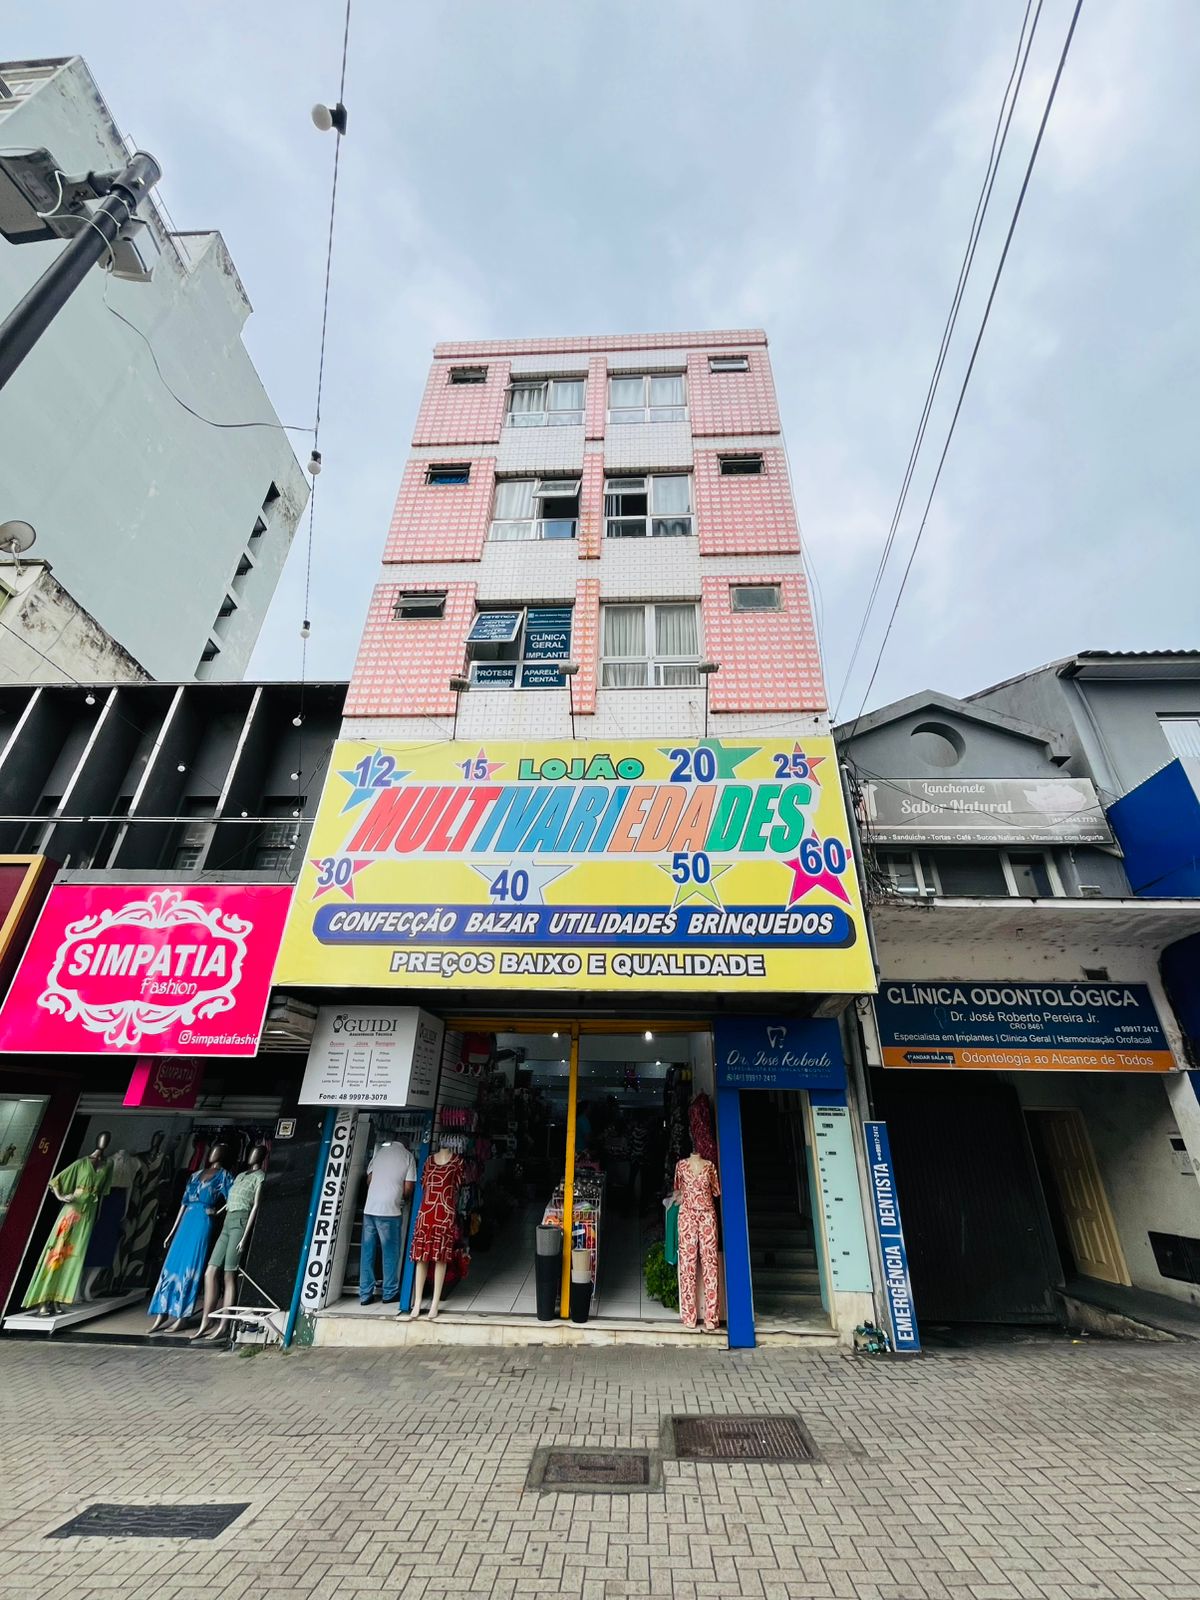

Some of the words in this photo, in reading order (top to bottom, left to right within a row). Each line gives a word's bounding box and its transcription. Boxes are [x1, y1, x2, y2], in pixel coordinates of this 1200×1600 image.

[530, 633, 566, 641] CLÍNICA
[532, 641, 564, 649] GERAL
[525, 651, 569, 659] IMPLANTE
[474, 669, 514, 677] PRÓTESE
[523, 668, 559, 676] APARELH
[355, 755, 396, 788] 12
[461, 758, 488, 780] 15
[517, 754, 645, 781] LOJÃO
[670, 749, 717, 783] 20
[772, 753, 809, 779] 25
[921, 783, 985, 796] Lanchonete
[900, 799, 945, 814] Sabor
[949, 799, 1014, 814] Natural
[345, 783, 813, 854] MULTIVARIEDADES
[799, 837, 847, 875] 60
[317, 857, 353, 886] 30
[672, 852, 711, 884] 50
[489, 869, 530, 901] 40
[327, 907, 459, 938] CONFECÇÃO
[463, 911, 541, 934] BAZAR
[547, 911, 678, 935] UTILIDADES
[686, 911, 835, 936] BRINQUEDOS
[67, 943, 227, 977] SIMPATIA
[389, 951, 495, 978] PREÇOS
[498, 952, 583, 975] BAIXO
[587, 953, 607, 975] E
[611, 953, 767, 977] QUALIDADE
[139, 977, 198, 996] Fashion
[886, 984, 968, 1005] CLÍNICA
[970, 985, 1140, 1007] ODONTOLÓGICA
[343, 1019, 399, 1032] GUIDI
[950, 1011, 967, 1022] Dr.
[969, 1011, 995, 1022] José
[997, 1011, 1041, 1023] Roberto
[1043, 1012, 1084, 1023] Pereira
[1086, 1012, 1100, 1024] Jr.
[893, 1032, 941, 1042] Especialista
[955, 1033, 995, 1043] Implantes
[1000, 1033, 1027, 1042] Clínica
[1029, 1034, 1052, 1043] Geral
[1057, 1034, 1115, 1045] Harmonização
[1116, 1035, 1153, 1044] Orofacial
[1121, 1025, 1141, 1033] 99917
[751, 1050, 779, 1066] José
[781, 1051, 833, 1068] Roberto
[961, 1051, 1031, 1066] Odontologia
[1034, 1055, 1049, 1064] ao
[1051, 1053, 1098, 1065] Alcance
[1101, 1054, 1115, 1065] de
[1118, 1054, 1154, 1066] Todos
[318, 1093, 338, 1101] Fone:
[874, 1162, 897, 1226] DENTISTA
[304, 1126, 347, 1301] CONSERTOS
[885, 1245, 915, 1342] EMERGÊNCIA
